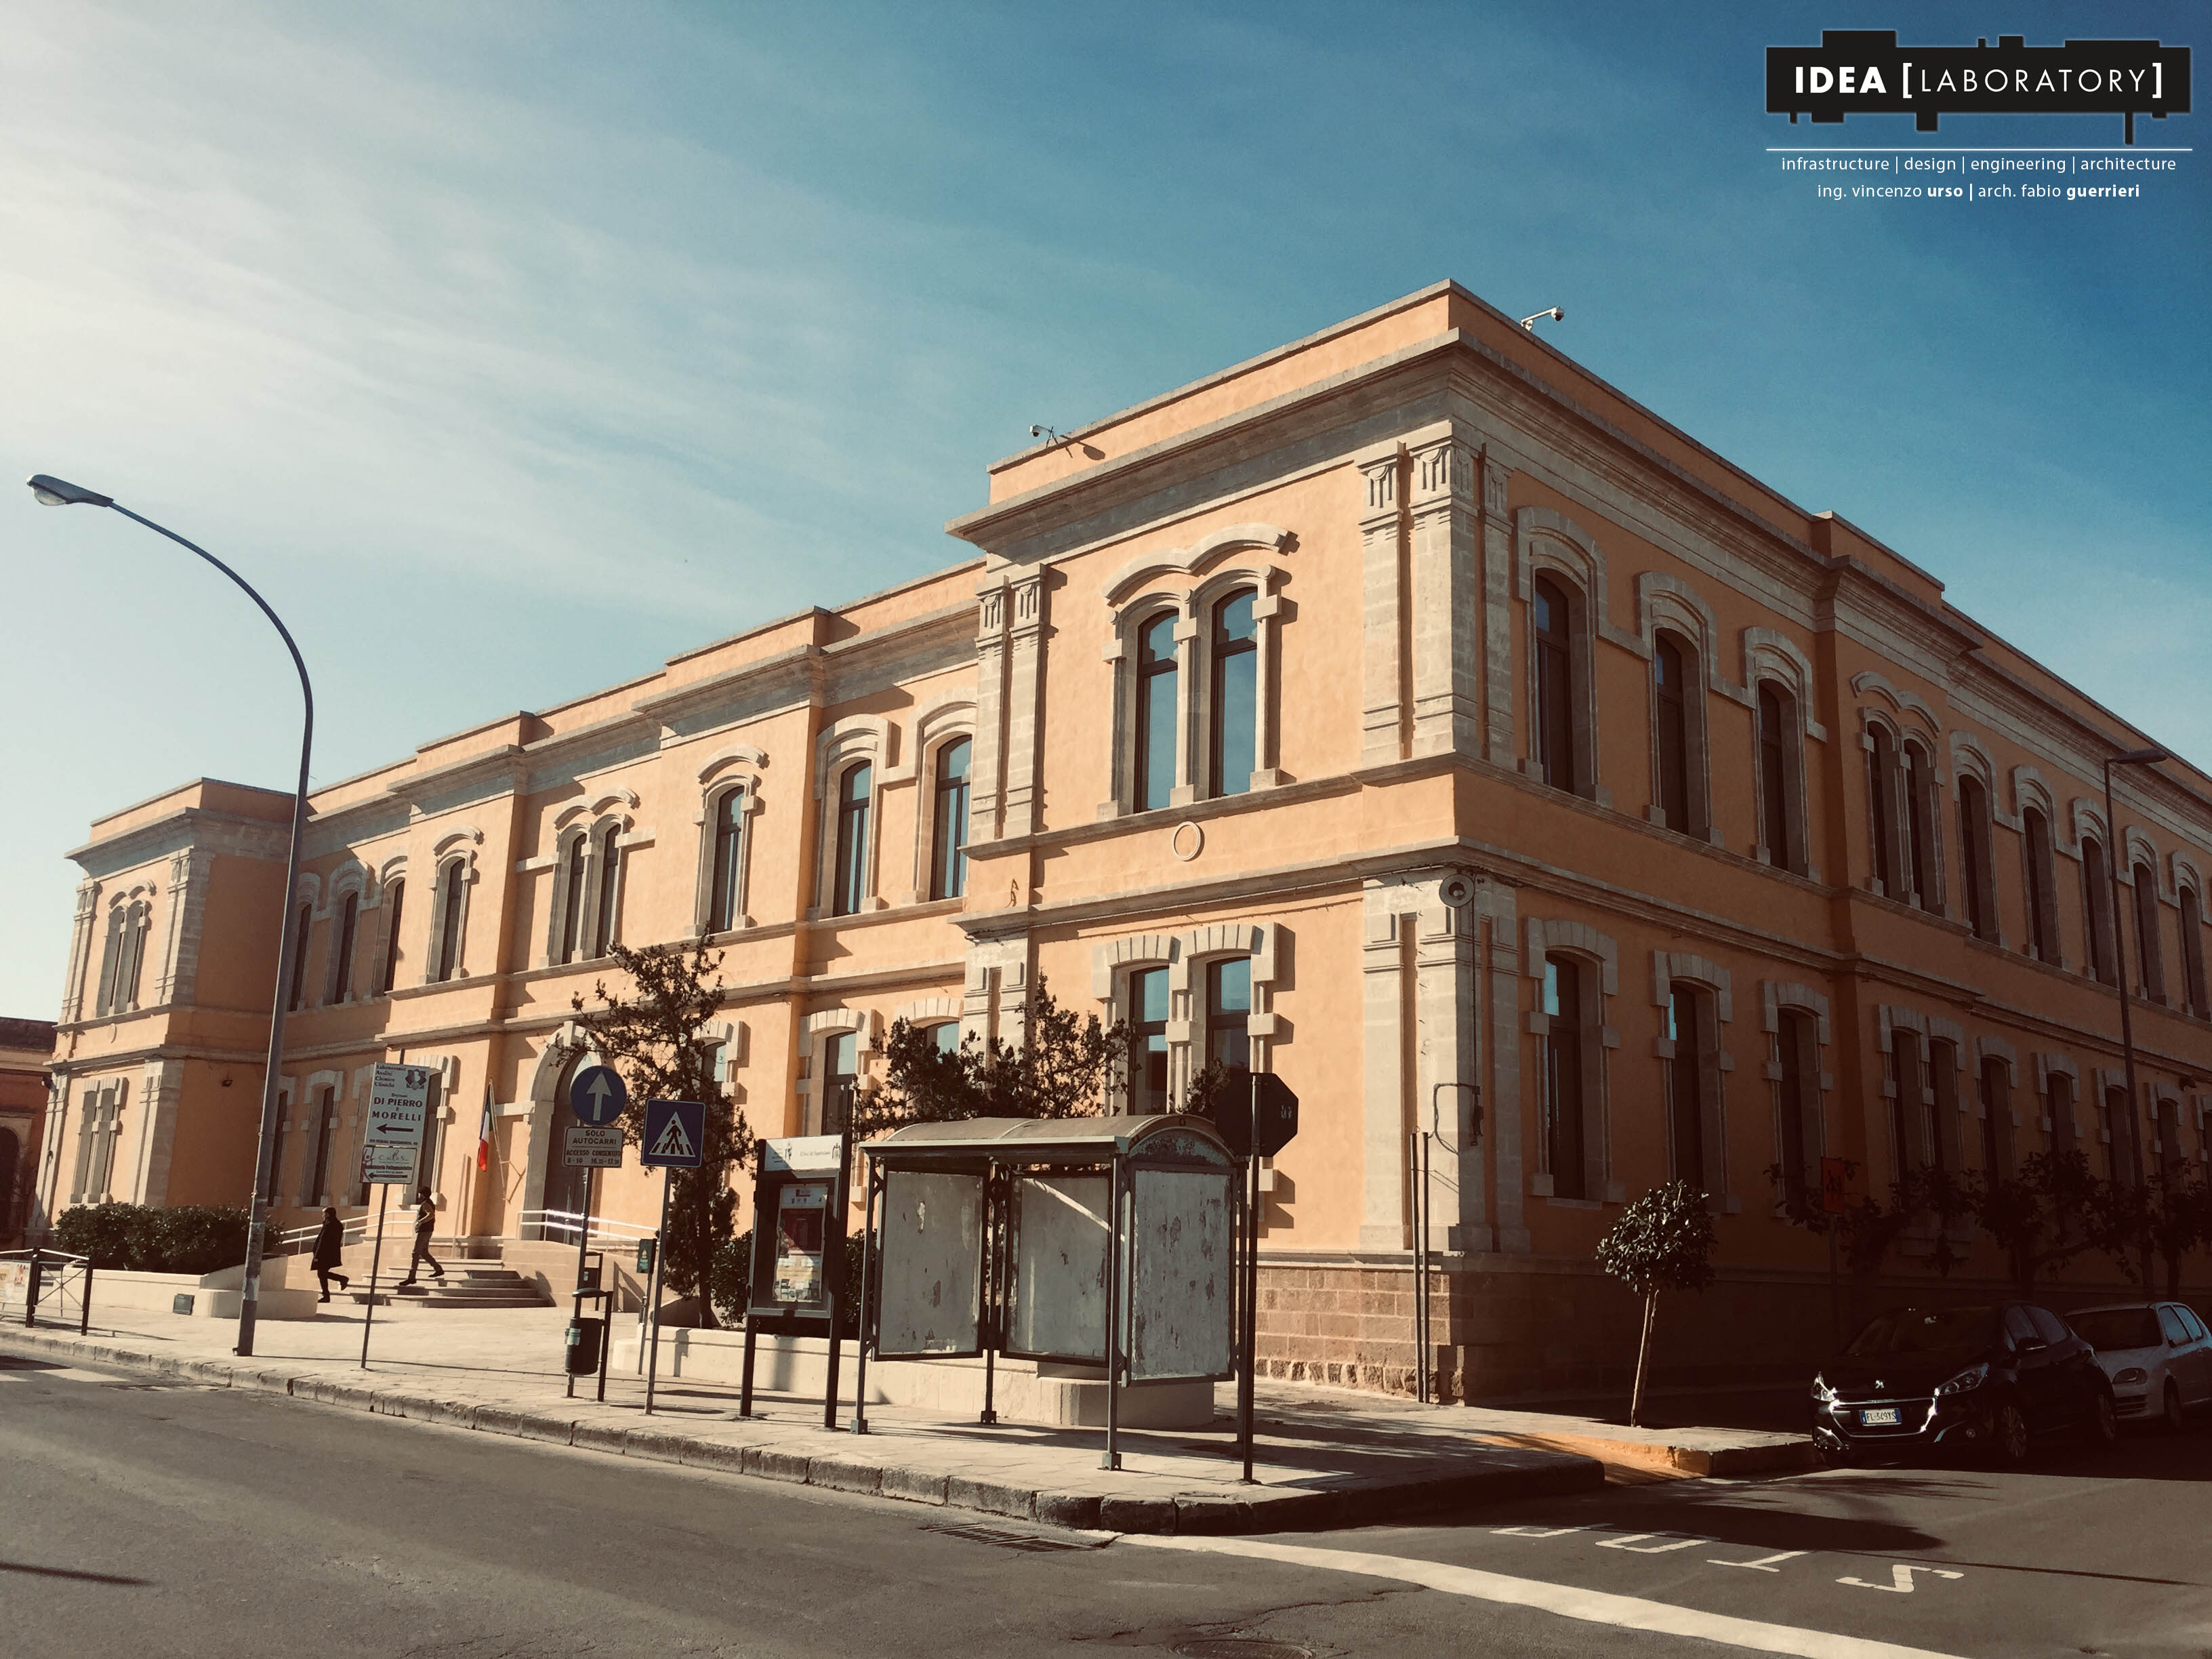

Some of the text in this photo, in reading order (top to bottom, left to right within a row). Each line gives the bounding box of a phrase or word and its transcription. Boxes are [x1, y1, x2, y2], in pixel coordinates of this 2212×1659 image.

[374, 1097, 423, 1108] DI PIERRO
[372, 1111, 422, 1122] MORELLI
